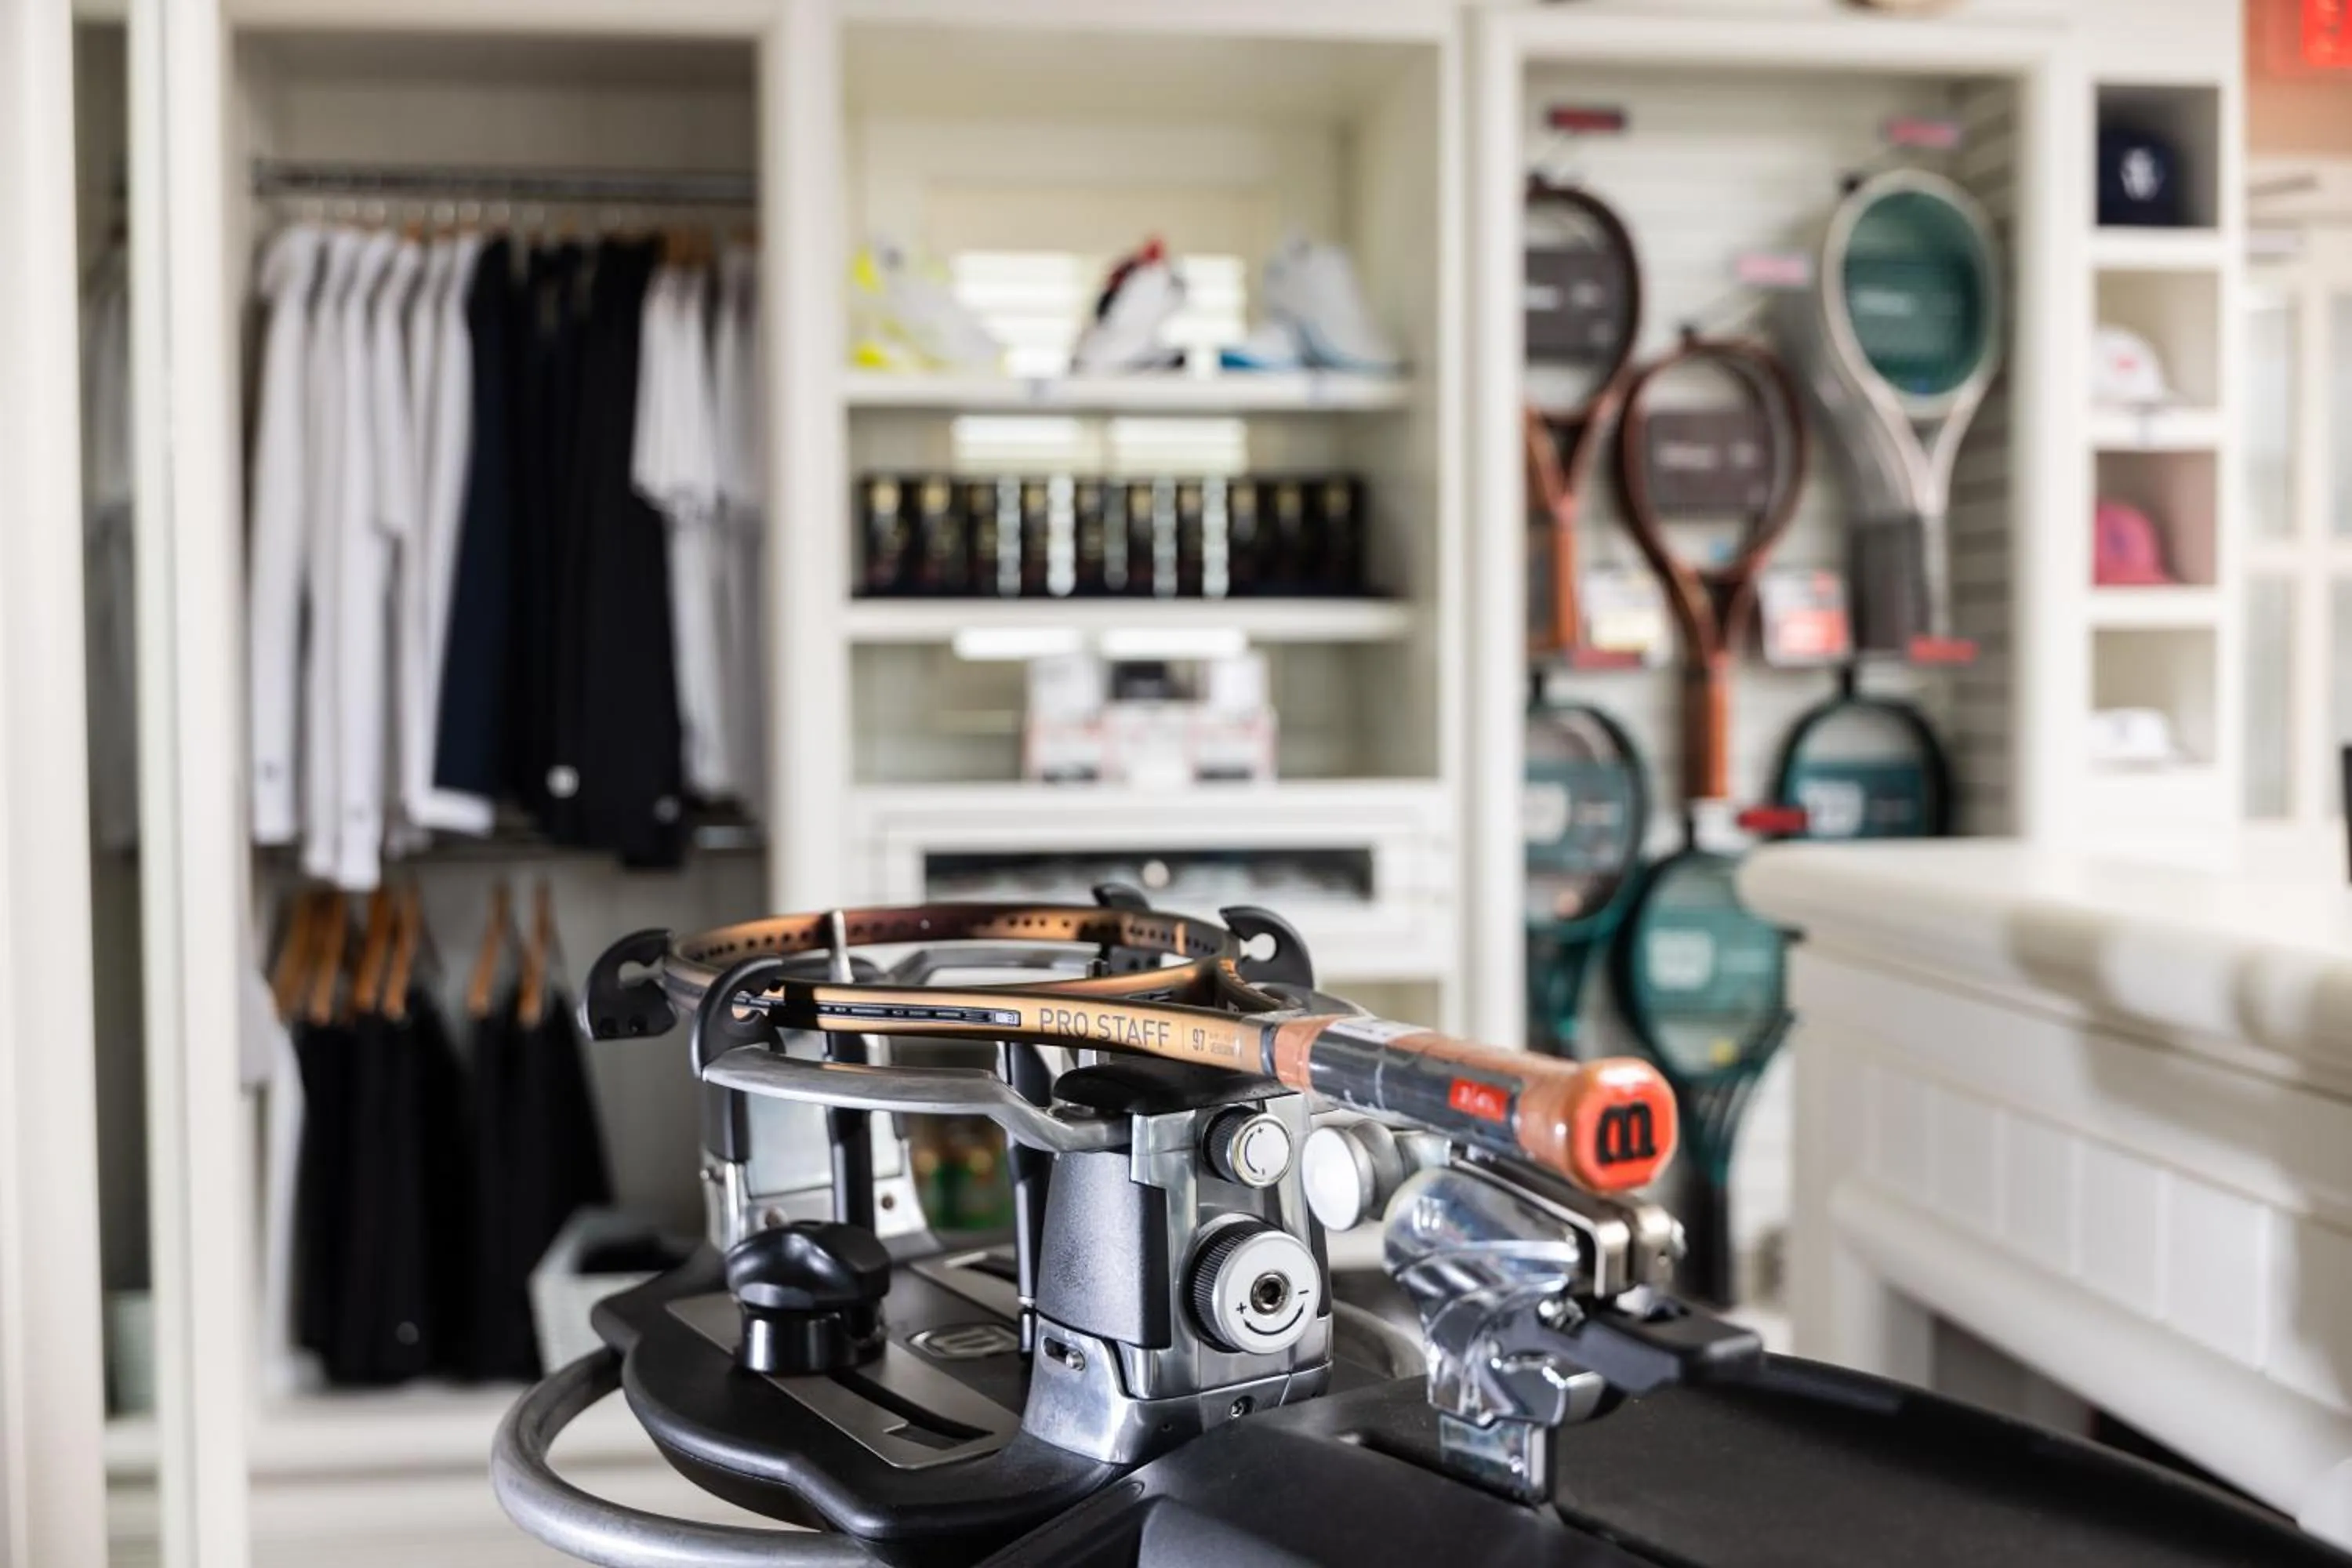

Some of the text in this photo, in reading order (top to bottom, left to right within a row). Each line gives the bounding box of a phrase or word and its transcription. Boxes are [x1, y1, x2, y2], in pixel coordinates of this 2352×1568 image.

[1040, 1007, 1089, 1039] PRO
[1097, 1014, 1171, 1047] STAFF
[1192, 1028, 1205, 1051] 97
